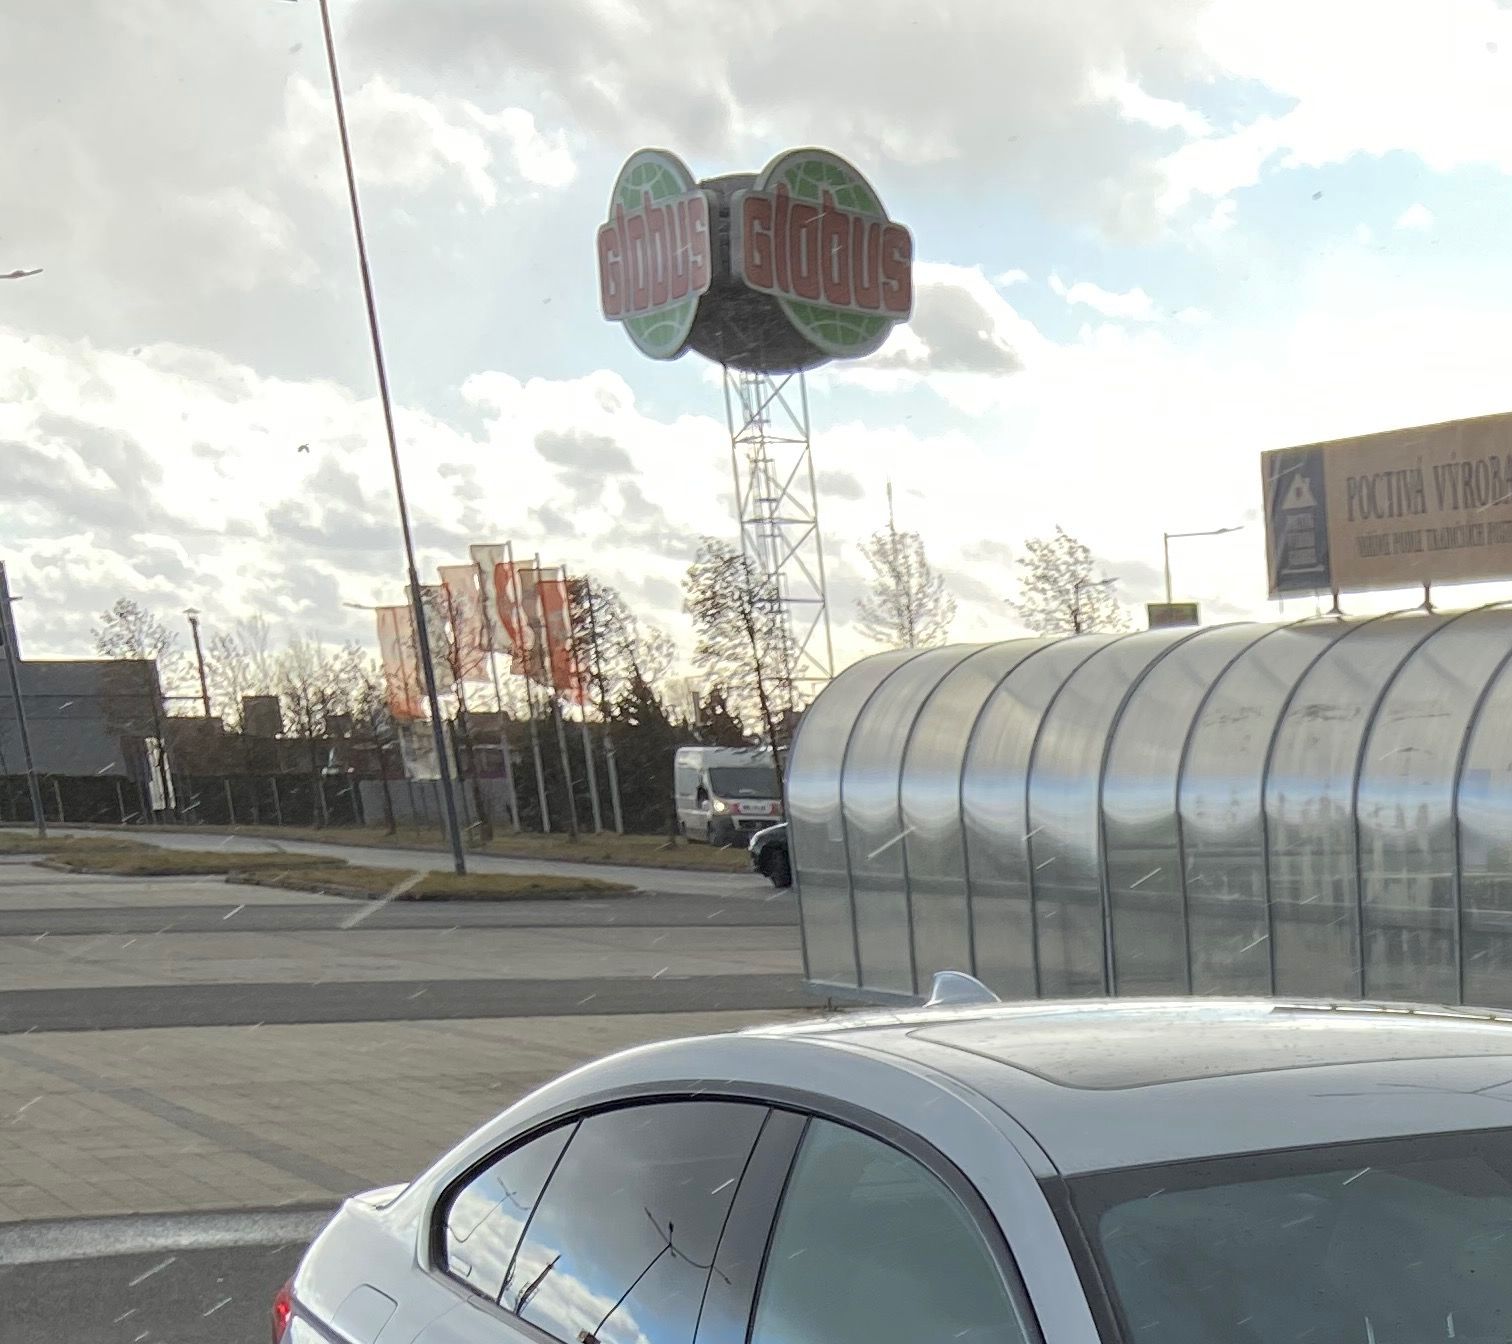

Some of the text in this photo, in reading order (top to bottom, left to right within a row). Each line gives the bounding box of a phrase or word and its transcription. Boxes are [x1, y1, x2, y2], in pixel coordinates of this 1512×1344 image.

[598, 191, 708, 318] Globus
[743, 182, 911, 311] Globus
[1347, 457, 1427, 522] POCTIVÁ
